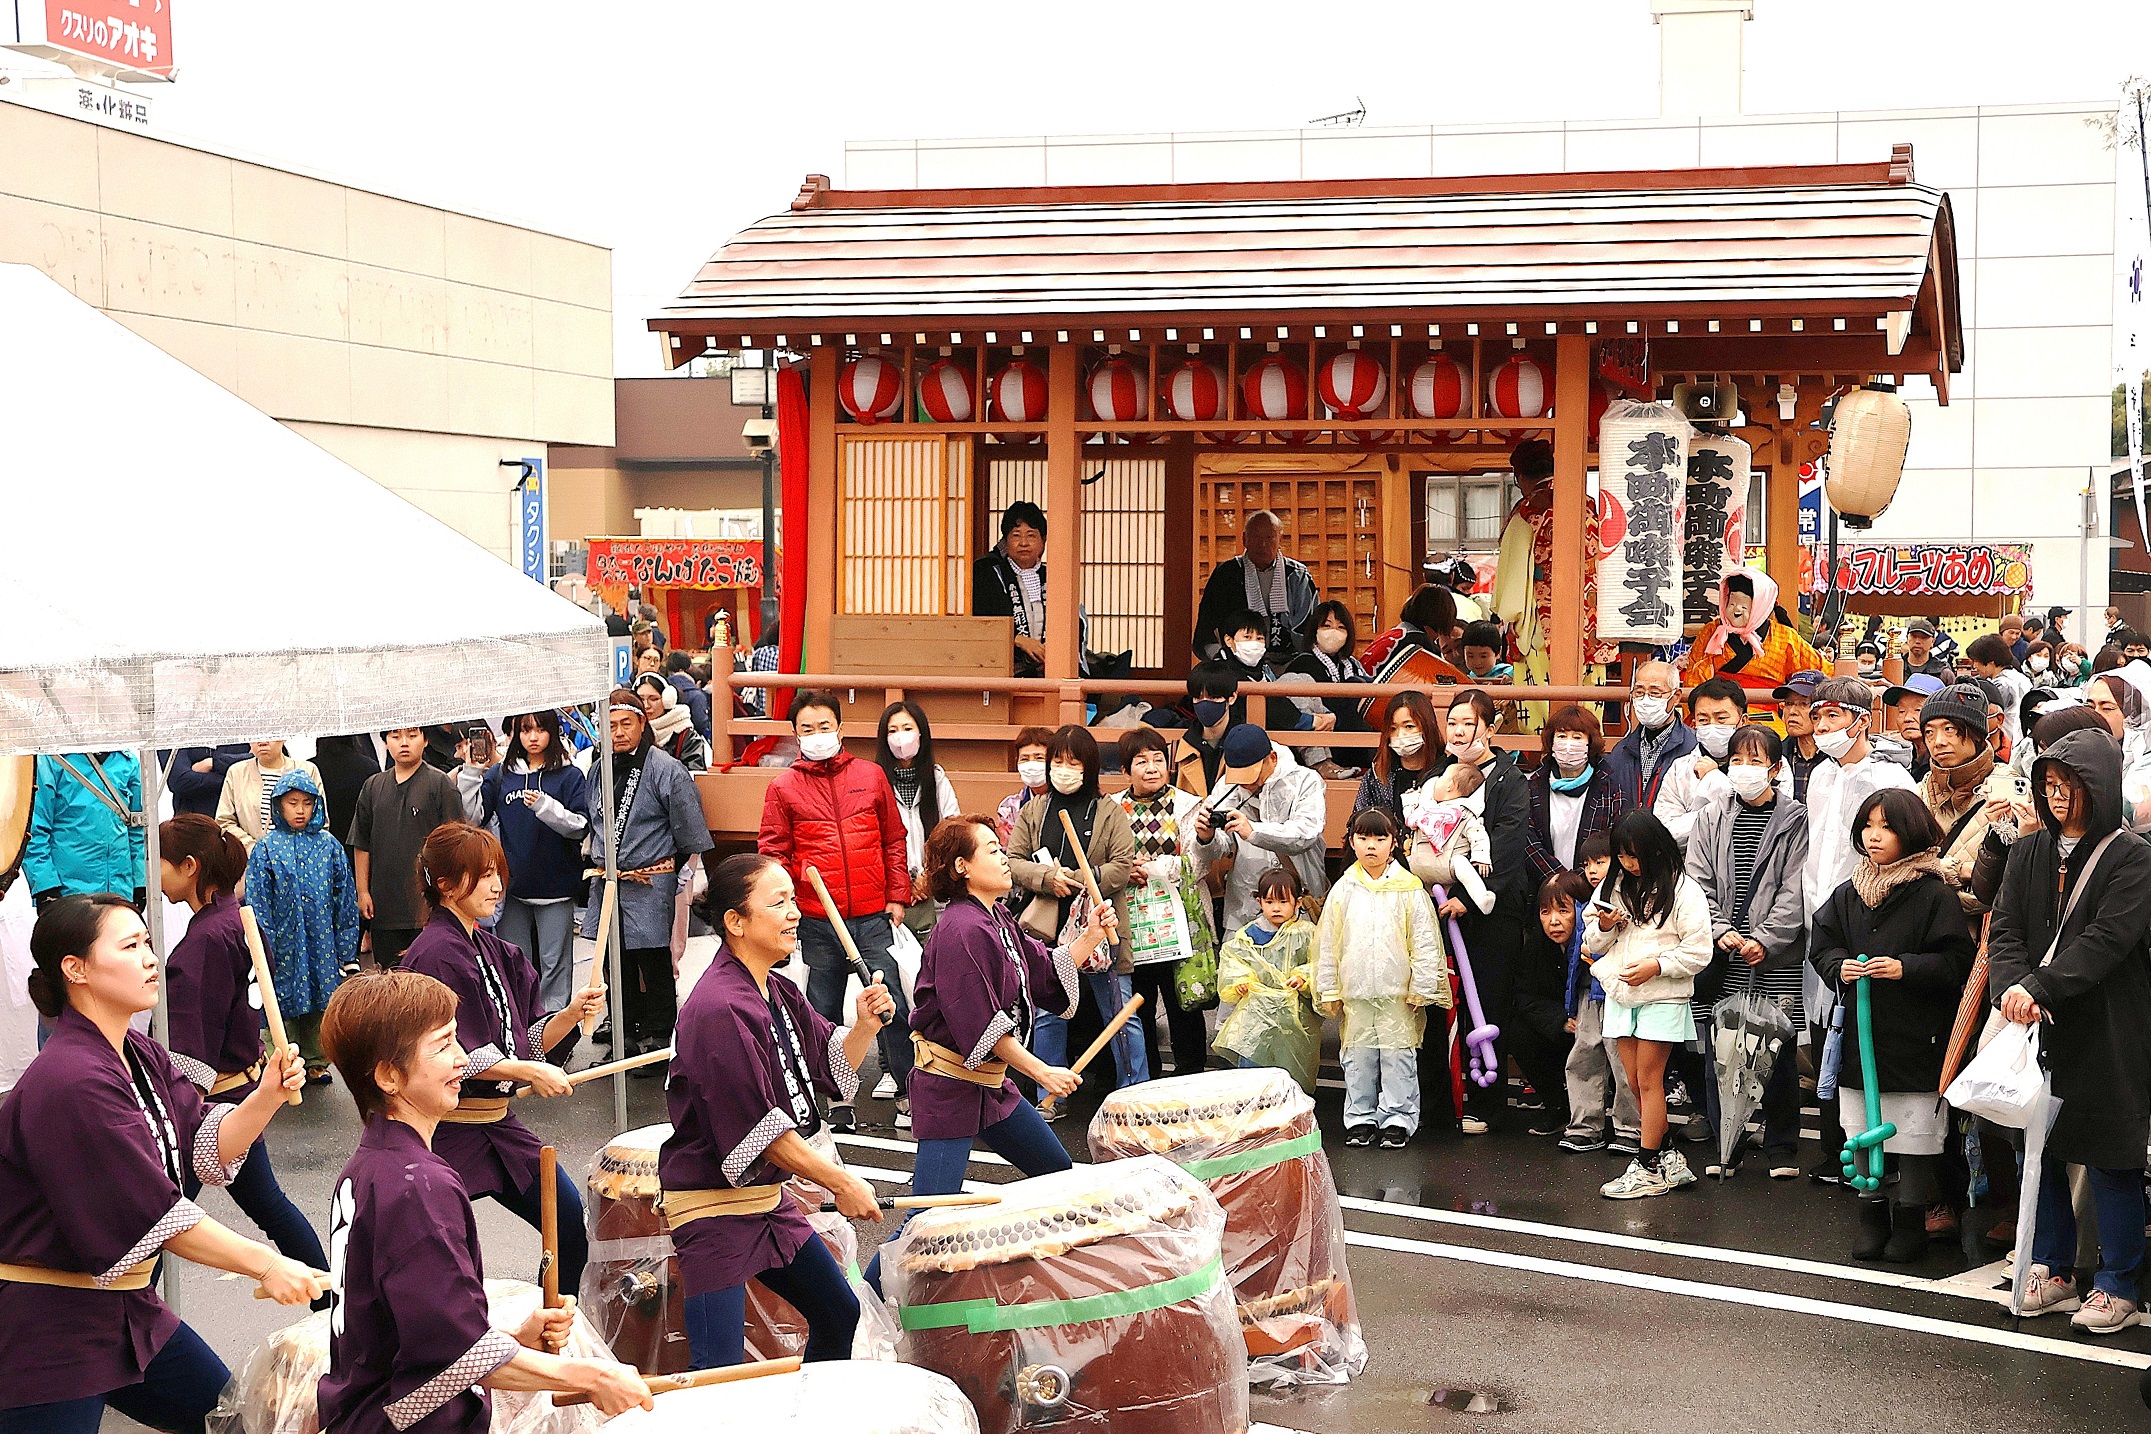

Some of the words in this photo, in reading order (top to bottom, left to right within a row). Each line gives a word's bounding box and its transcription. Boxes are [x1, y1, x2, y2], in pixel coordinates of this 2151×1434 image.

[60, 9, 158, 62] クスリのアオキ
[78, 88, 149, 125] 薬・化粧品
[1851, 547, 1994, 590] フルーツあめ
[1271, 612, 1282, 646] 本町会
[618, 651, 628, 678] P
